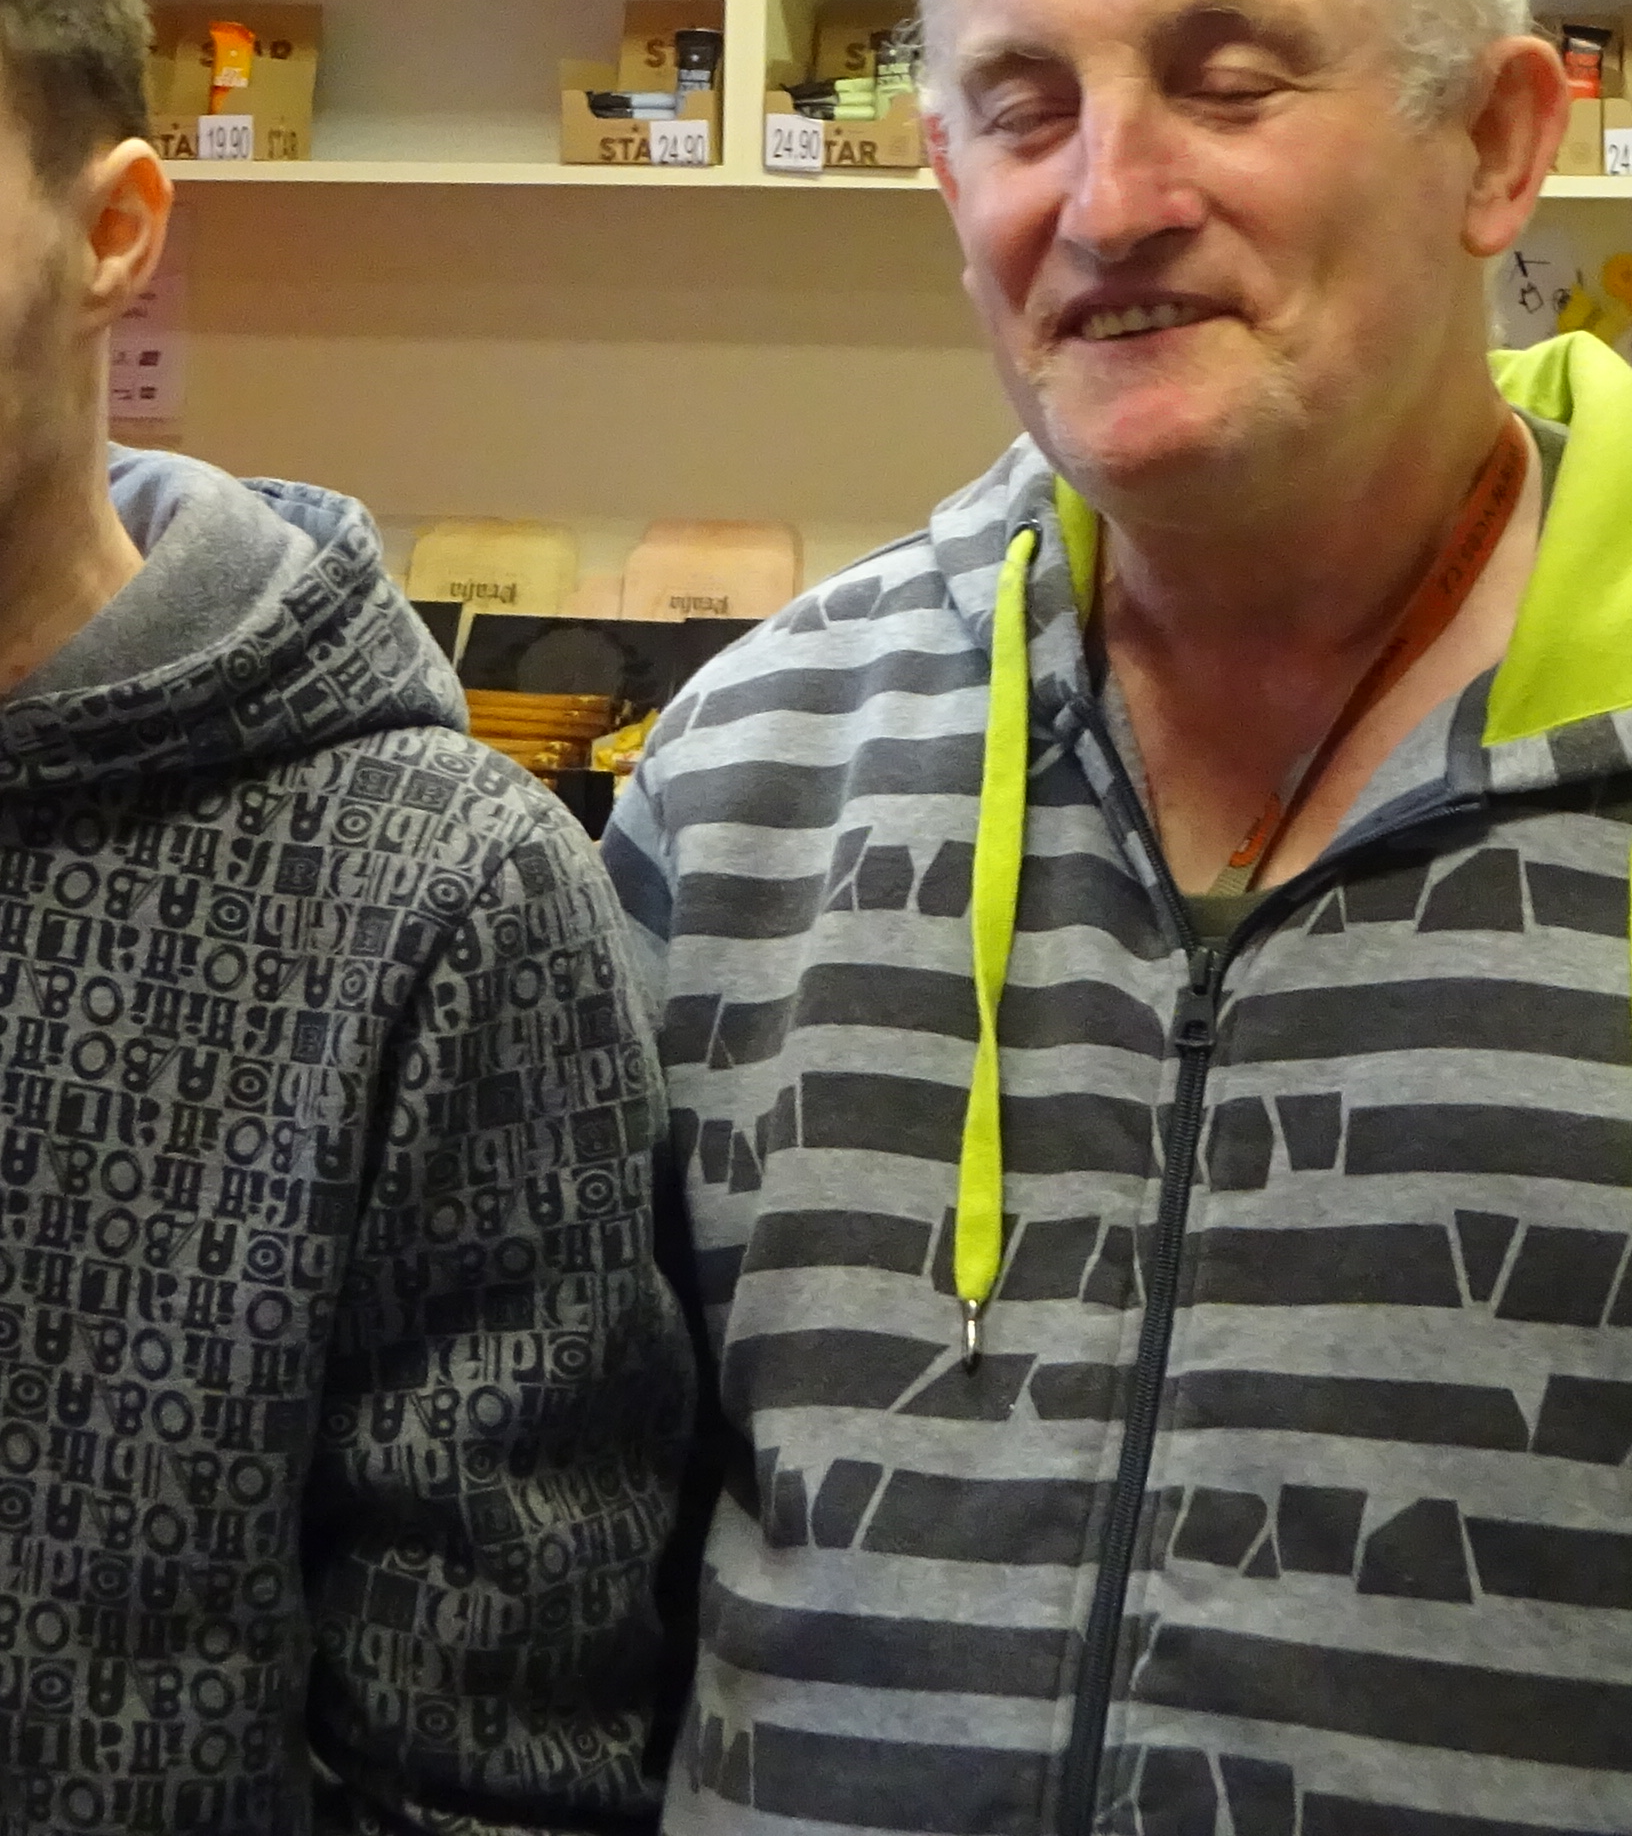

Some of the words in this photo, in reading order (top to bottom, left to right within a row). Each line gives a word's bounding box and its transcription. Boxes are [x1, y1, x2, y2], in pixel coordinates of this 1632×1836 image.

[599, 136, 651, 161] STA
[772, 128, 820, 160] 24.90
[824, 139, 880, 165] TAR
